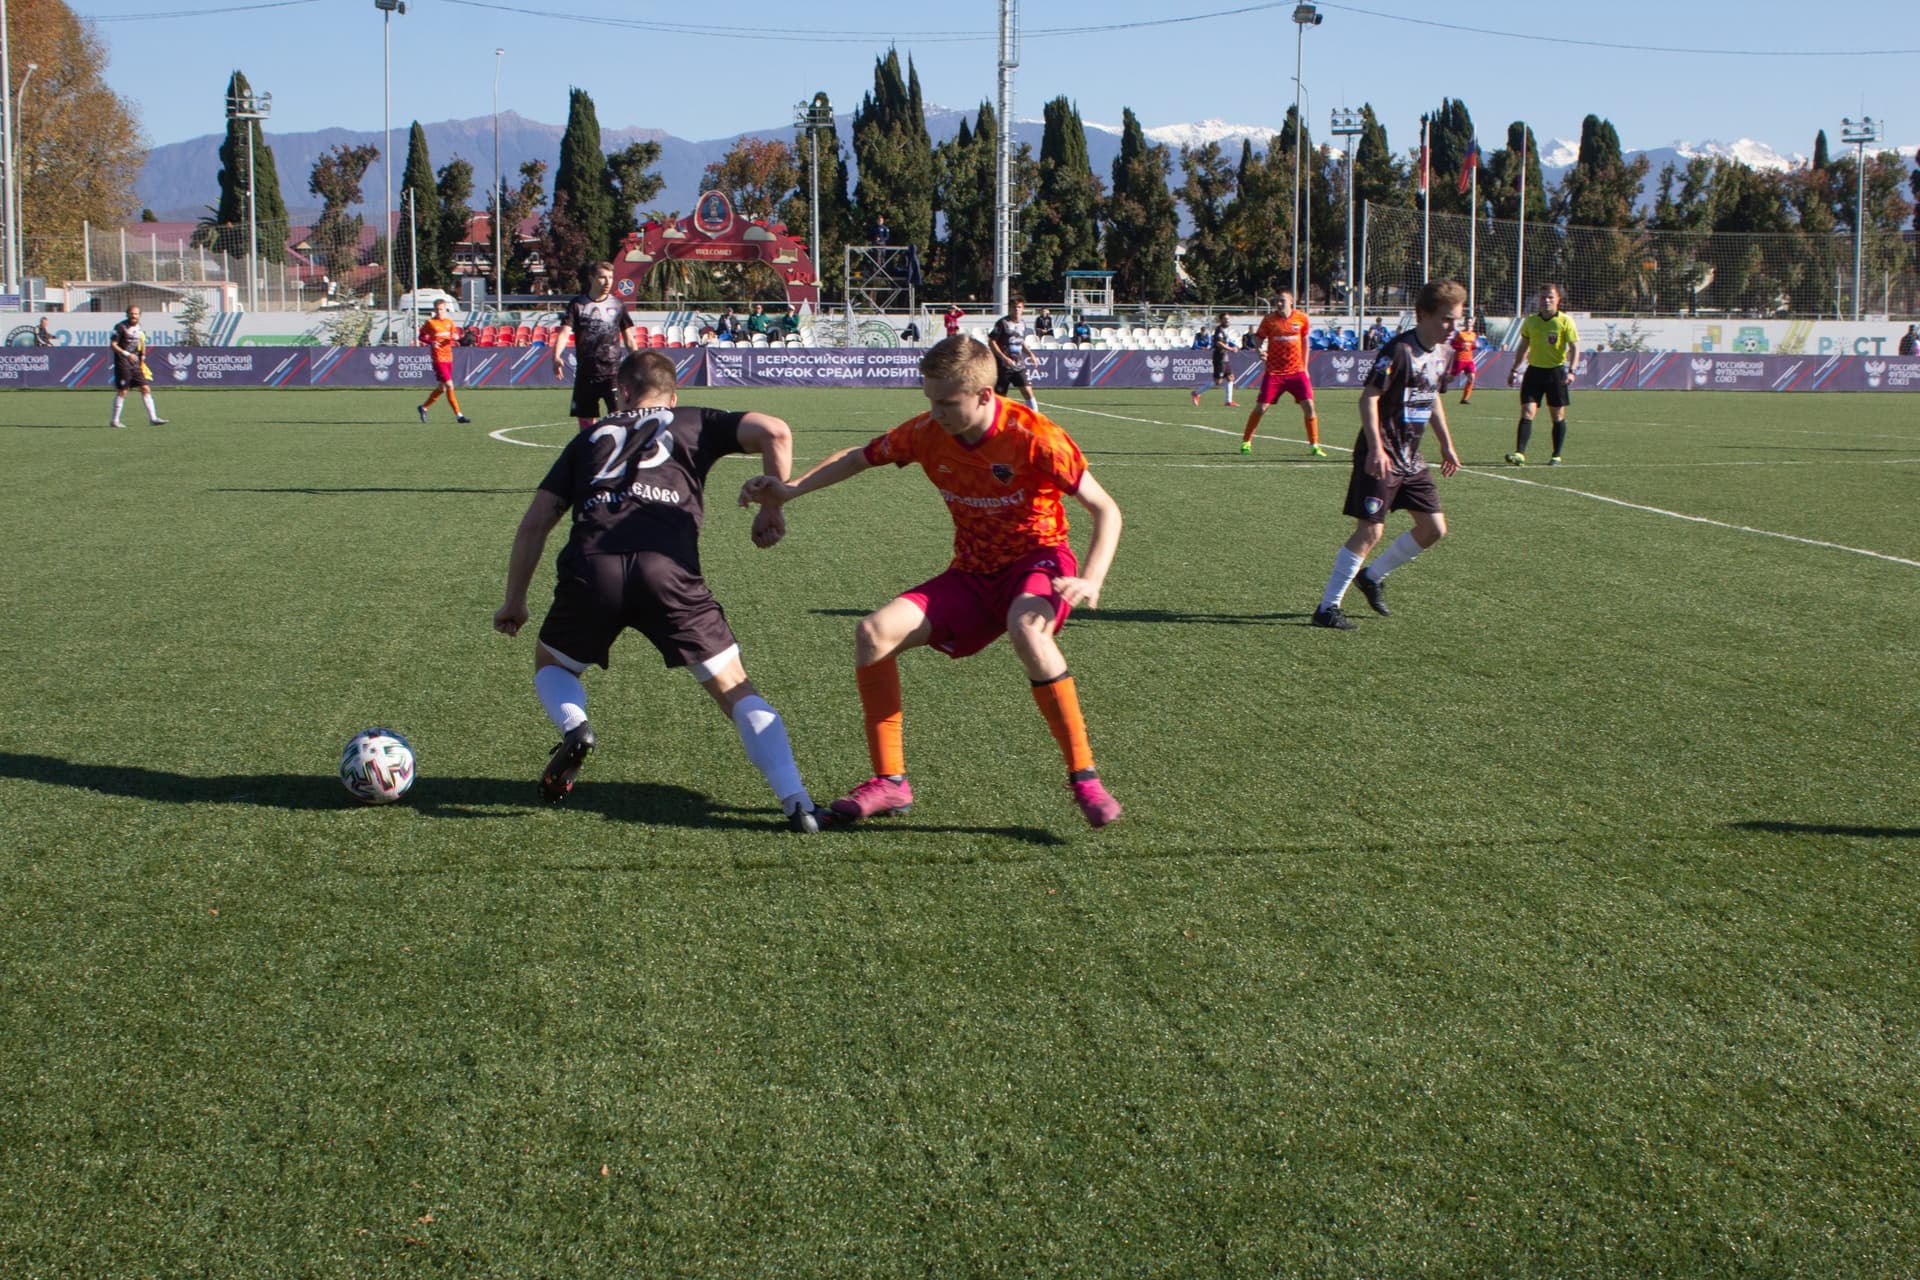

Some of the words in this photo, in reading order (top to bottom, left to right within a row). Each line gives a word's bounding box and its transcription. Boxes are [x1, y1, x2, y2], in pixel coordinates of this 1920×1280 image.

[0, 354, 49, 364] ОССИЙСКИЙ
[197, 354, 253, 363] РОССИЙСКИЙ
[398, 354, 433, 363] РОССИЙ
[715, 355, 743, 363] СОЧИ
[756, 353, 865, 364] ВСЕРОССИЙСКИЕ
[867, 355, 925, 364] СОРЕВНО
[1172, 357, 1214, 366] РОССИЙСК
[0, 363, 49, 371] УТБОЛЬНЫЙ
[197, 363, 253, 371] ФУТБОЛЬНЫЙ
[398, 363, 433, 371] ФУТБОЛЬ
[1715, 360, 1764, 369] РОССИЙСКИЙ
[1888, 363, 1920, 371] РОССИЙС
[0, 371, 19, 379] ОЮЗ
[197, 371, 222, 379] СОЮЗ
[715, 369, 743, 378] 2021
[757, 367, 814, 377] «КУБОК
[817, 367, 863, 378] СРЕДИ
[1715, 368, 1764, 376] ФУТБОЛЬНЫЙ
[1888, 378, 1909, 386] СОЮЗ
